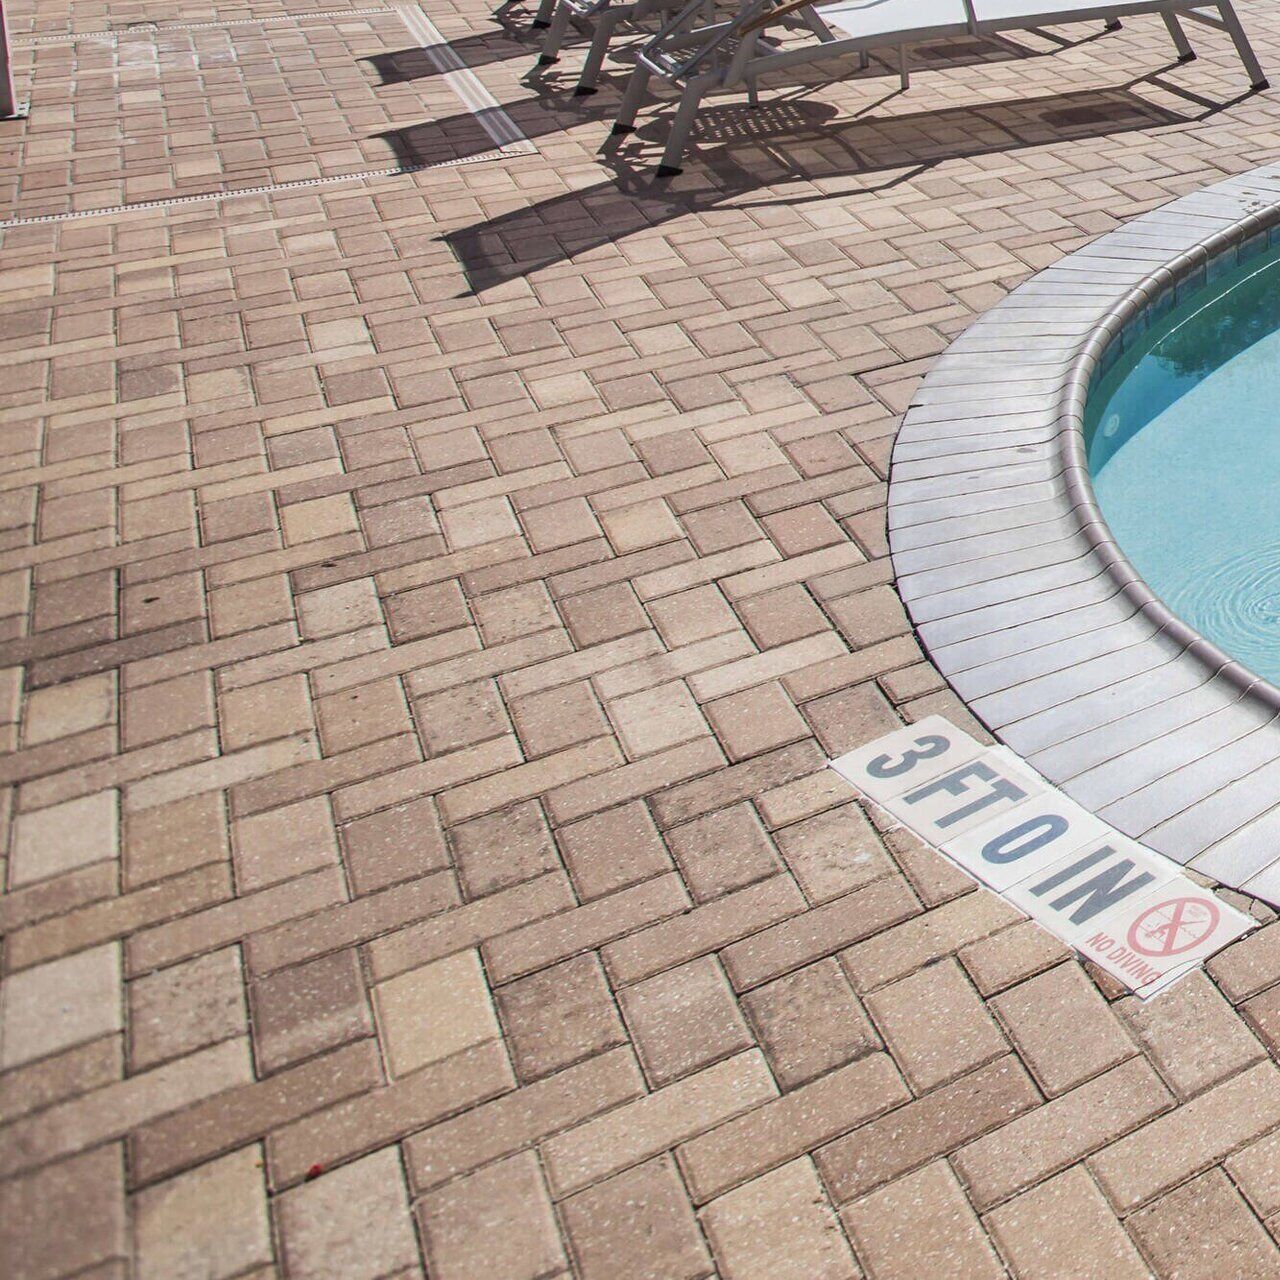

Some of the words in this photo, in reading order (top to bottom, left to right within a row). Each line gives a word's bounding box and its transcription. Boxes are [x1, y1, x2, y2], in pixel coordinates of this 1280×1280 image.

[866, 734, 951, 779] 3
[902, 760, 1028, 829] FT
[1029, 845, 1156, 926] IN
[1085, 932, 1116, 952] NO
[1106, 946, 1162, 985] DIVING
